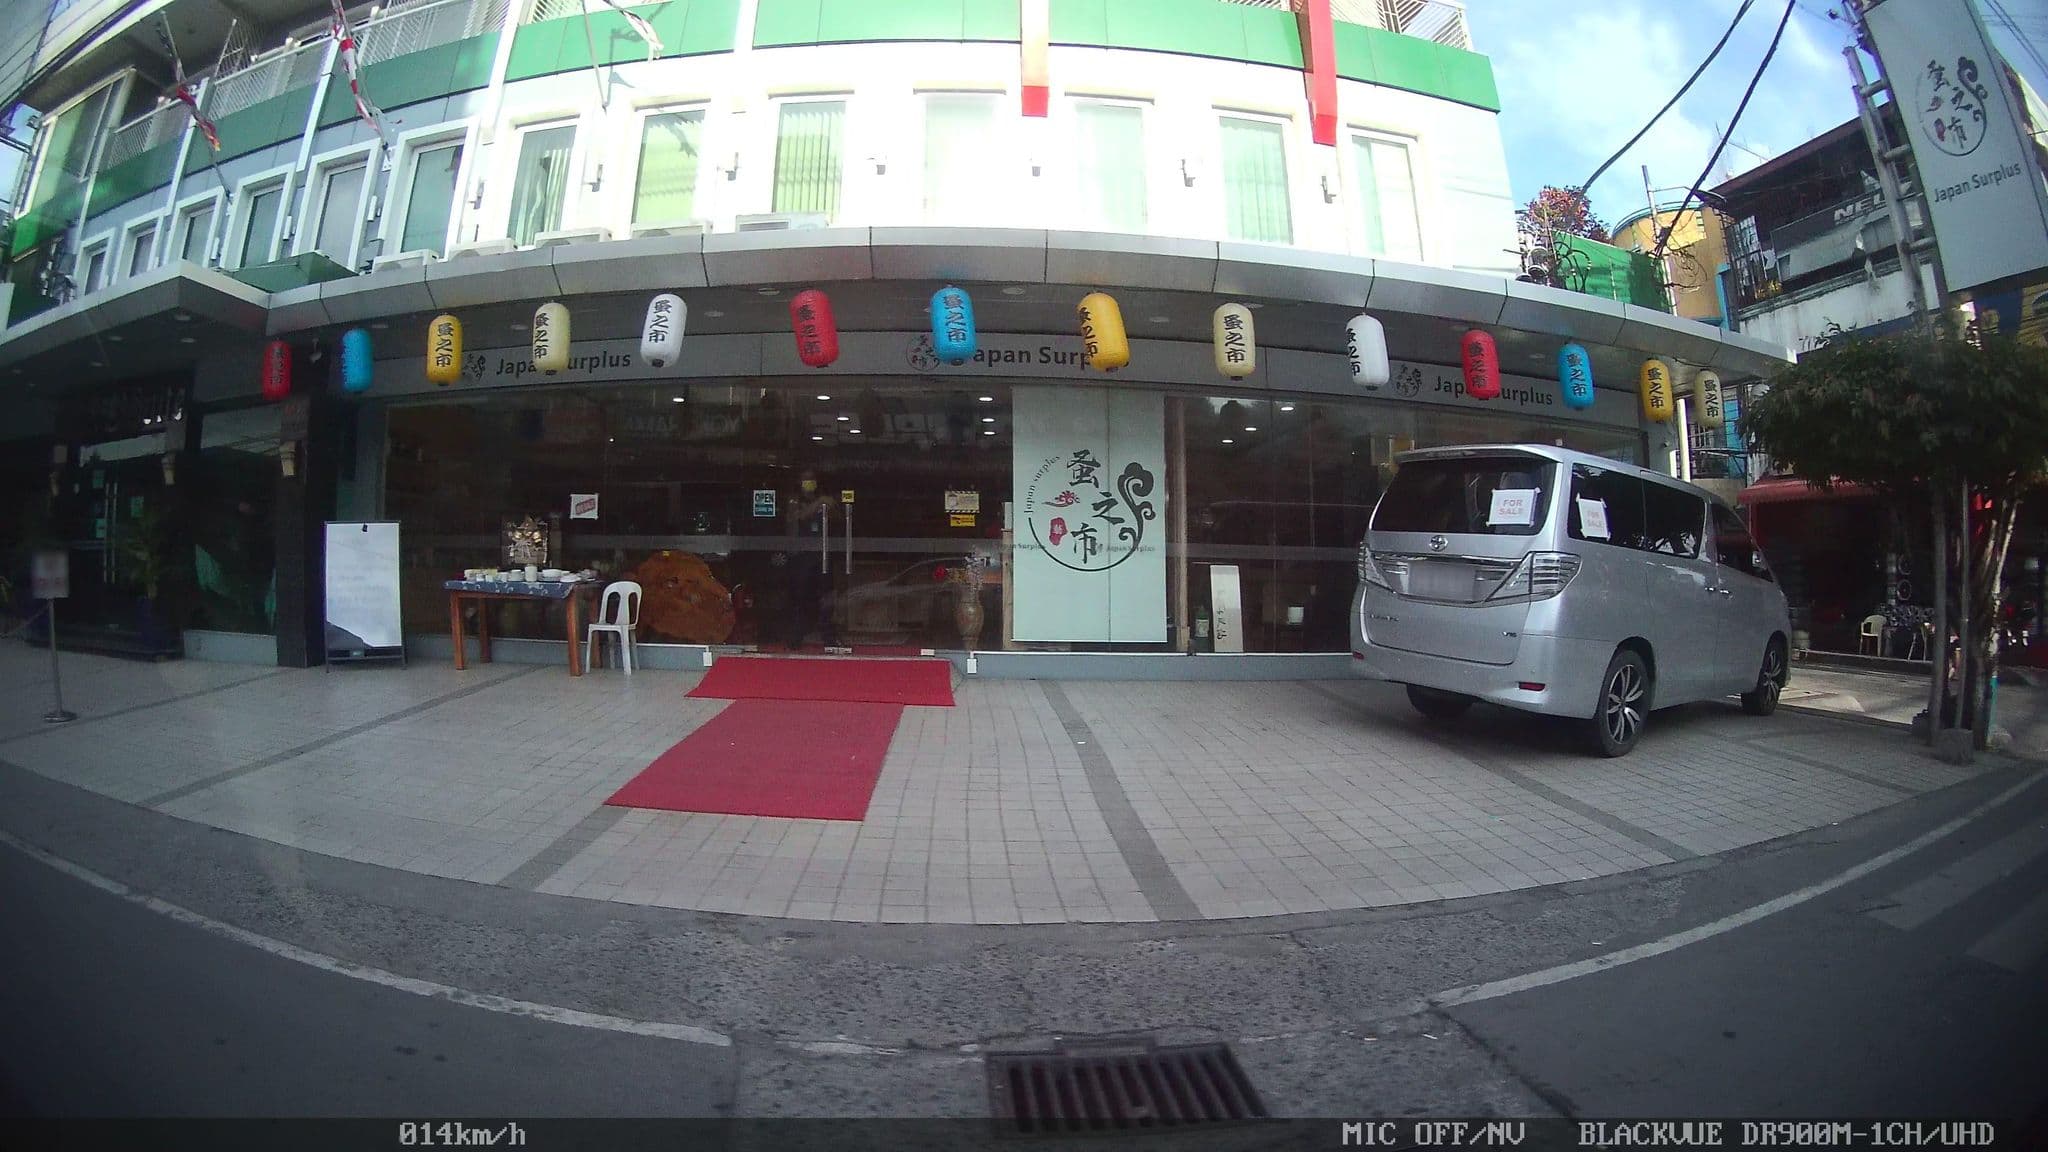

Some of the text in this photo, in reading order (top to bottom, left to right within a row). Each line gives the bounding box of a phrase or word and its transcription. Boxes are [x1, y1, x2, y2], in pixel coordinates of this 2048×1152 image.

[1933, 162, 2022, 203] Japan Surplus
[534, 312, 549, 359] 蚤之市
[649, 299, 673, 344] 蚤之市
[1223, 314, 1245, 364] 蚤之市
[435, 322, 454, 367] 蚤之市
[972, 347, 1031, 368] apan
[496, 358, 537, 379] Japa
[1648, 367, 1664, 409] 蚤之市
[1501, 386, 1553, 406] urplus
[1703, 379, 1719, 418] 蚤之市
[1066, 449, 1126, 565] 蚤之市
